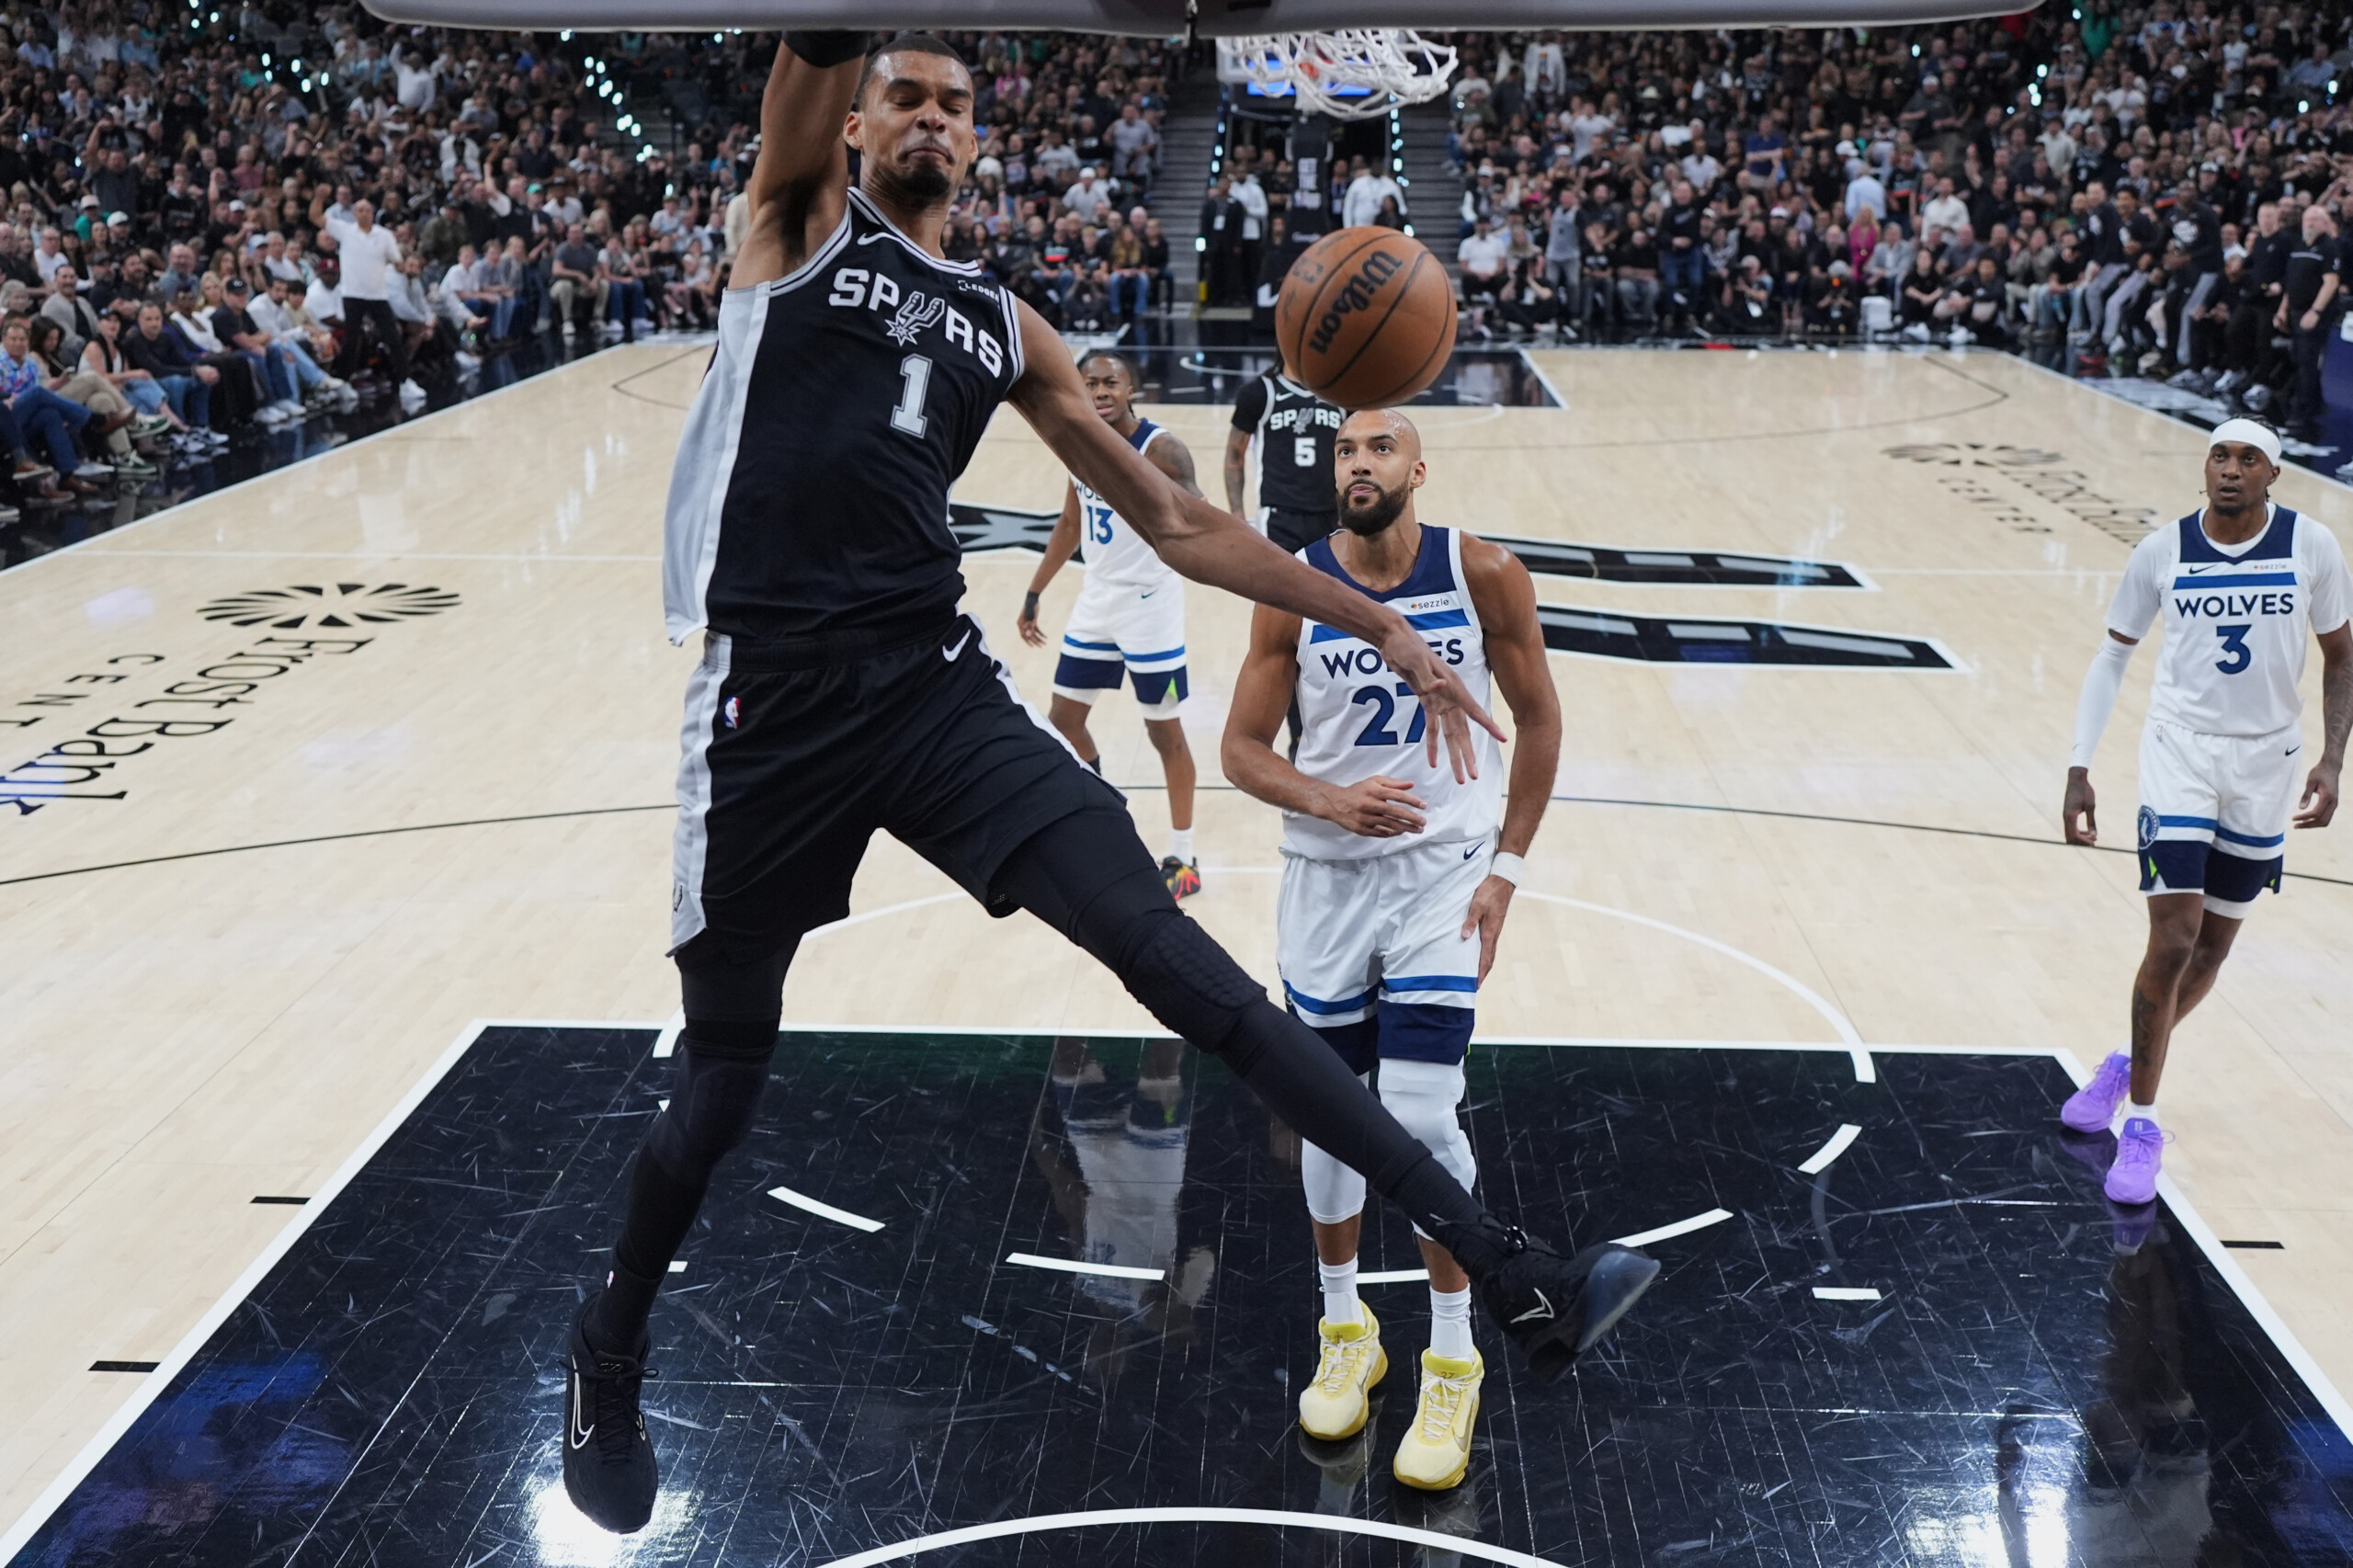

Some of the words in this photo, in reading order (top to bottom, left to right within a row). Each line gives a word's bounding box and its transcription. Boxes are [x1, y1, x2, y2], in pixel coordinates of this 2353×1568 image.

[828, 267, 1004, 379] SPURS
[1309, 250, 1404, 355] Wilson
[889, 353, 934, 439] 1
[1269, 407, 1342, 432] SPURS
[1294, 437, 1316, 467] 5
[1086, 506, 1114, 545] 13
[1417, 597, 1449, 608] sezzle
[2175, 593, 2294, 619] WOLVES
[1320, 638, 1465, 679] WOS
[2214, 624, 2253, 675] 3
[134, 636, 376, 710] Frost
